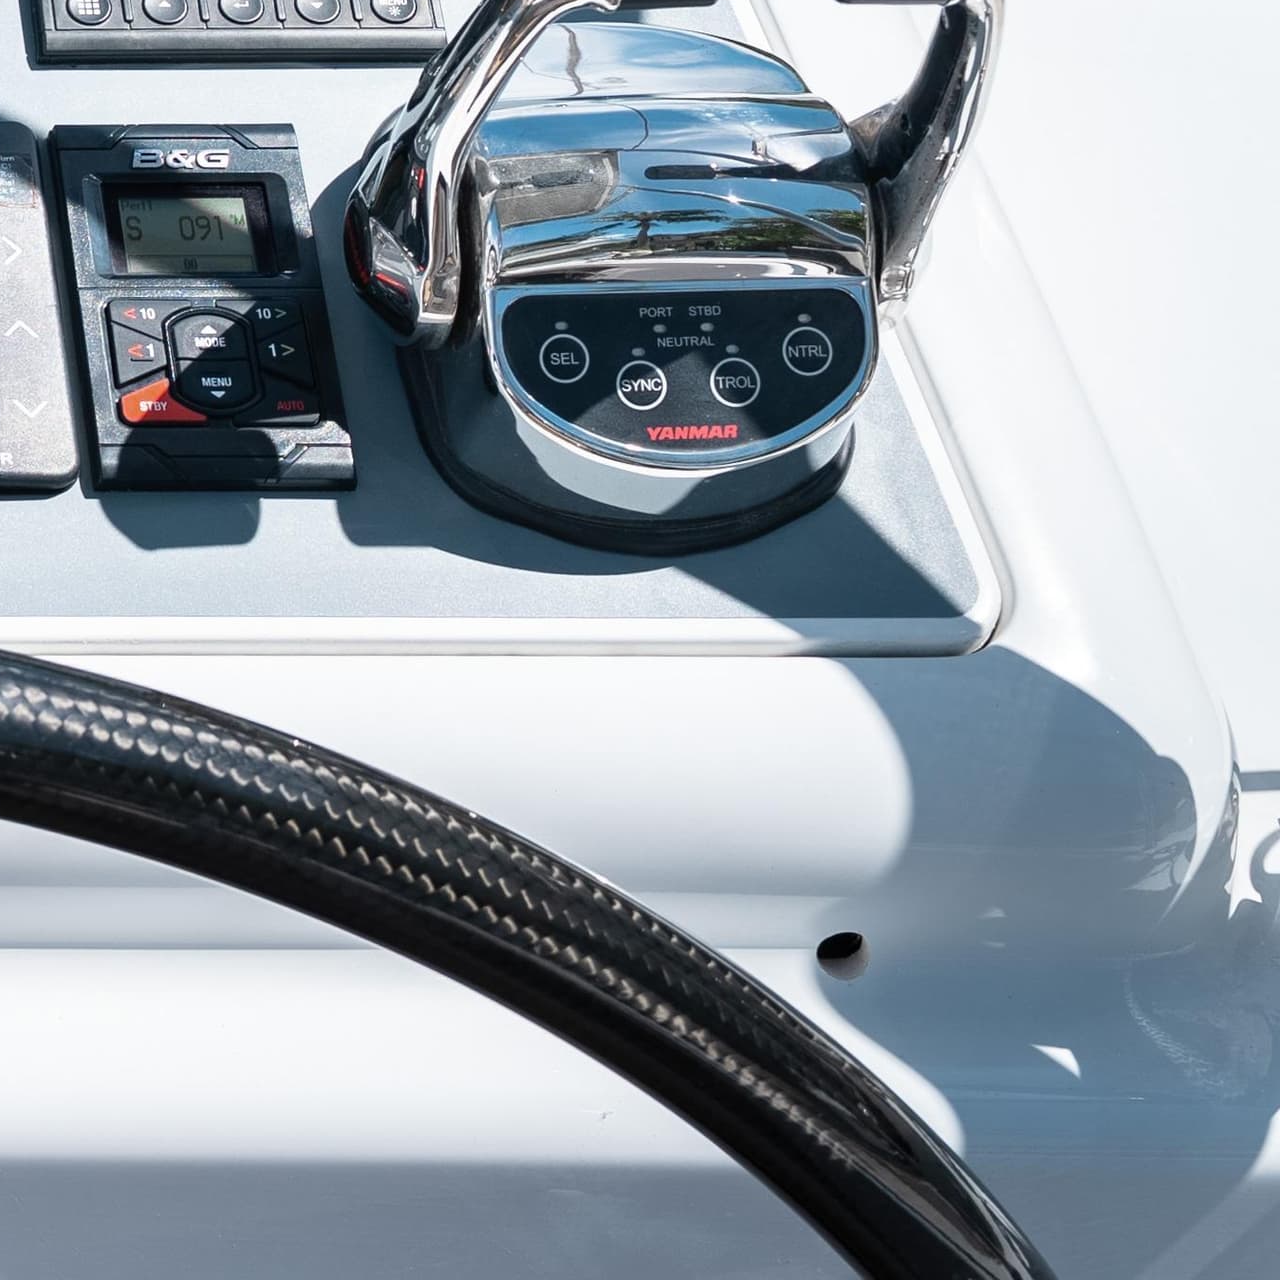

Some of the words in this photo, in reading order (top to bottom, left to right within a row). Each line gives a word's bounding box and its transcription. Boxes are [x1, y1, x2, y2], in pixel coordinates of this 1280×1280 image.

[132, 149, 230, 169] B&G
[126, 216, 142, 240] S
[178, 216, 224, 240] 091
[140, 308, 156, 320] 10
[256, 308, 272, 320] 10
[640, 307, 672, 318] PORT
[688, 306, 722, 317] STBD
[196, 336, 226, 348] MODE
[656, 336, 716, 348] NEUTRAL
[146, 343, 154, 358] 1
[268, 343, 276, 358] 1
[788, 344, 827, 358] NTRL
[550, 352, 580, 366] SEL
[202, 376, 232, 388] MENU
[620, 378, 662, 392] SYNC
[716, 376, 756, 389] TROL
[139, 400, 168, 412] STBY
[276, 400, 304, 412] AUTO
[646, 424, 738, 440] YANMAR
